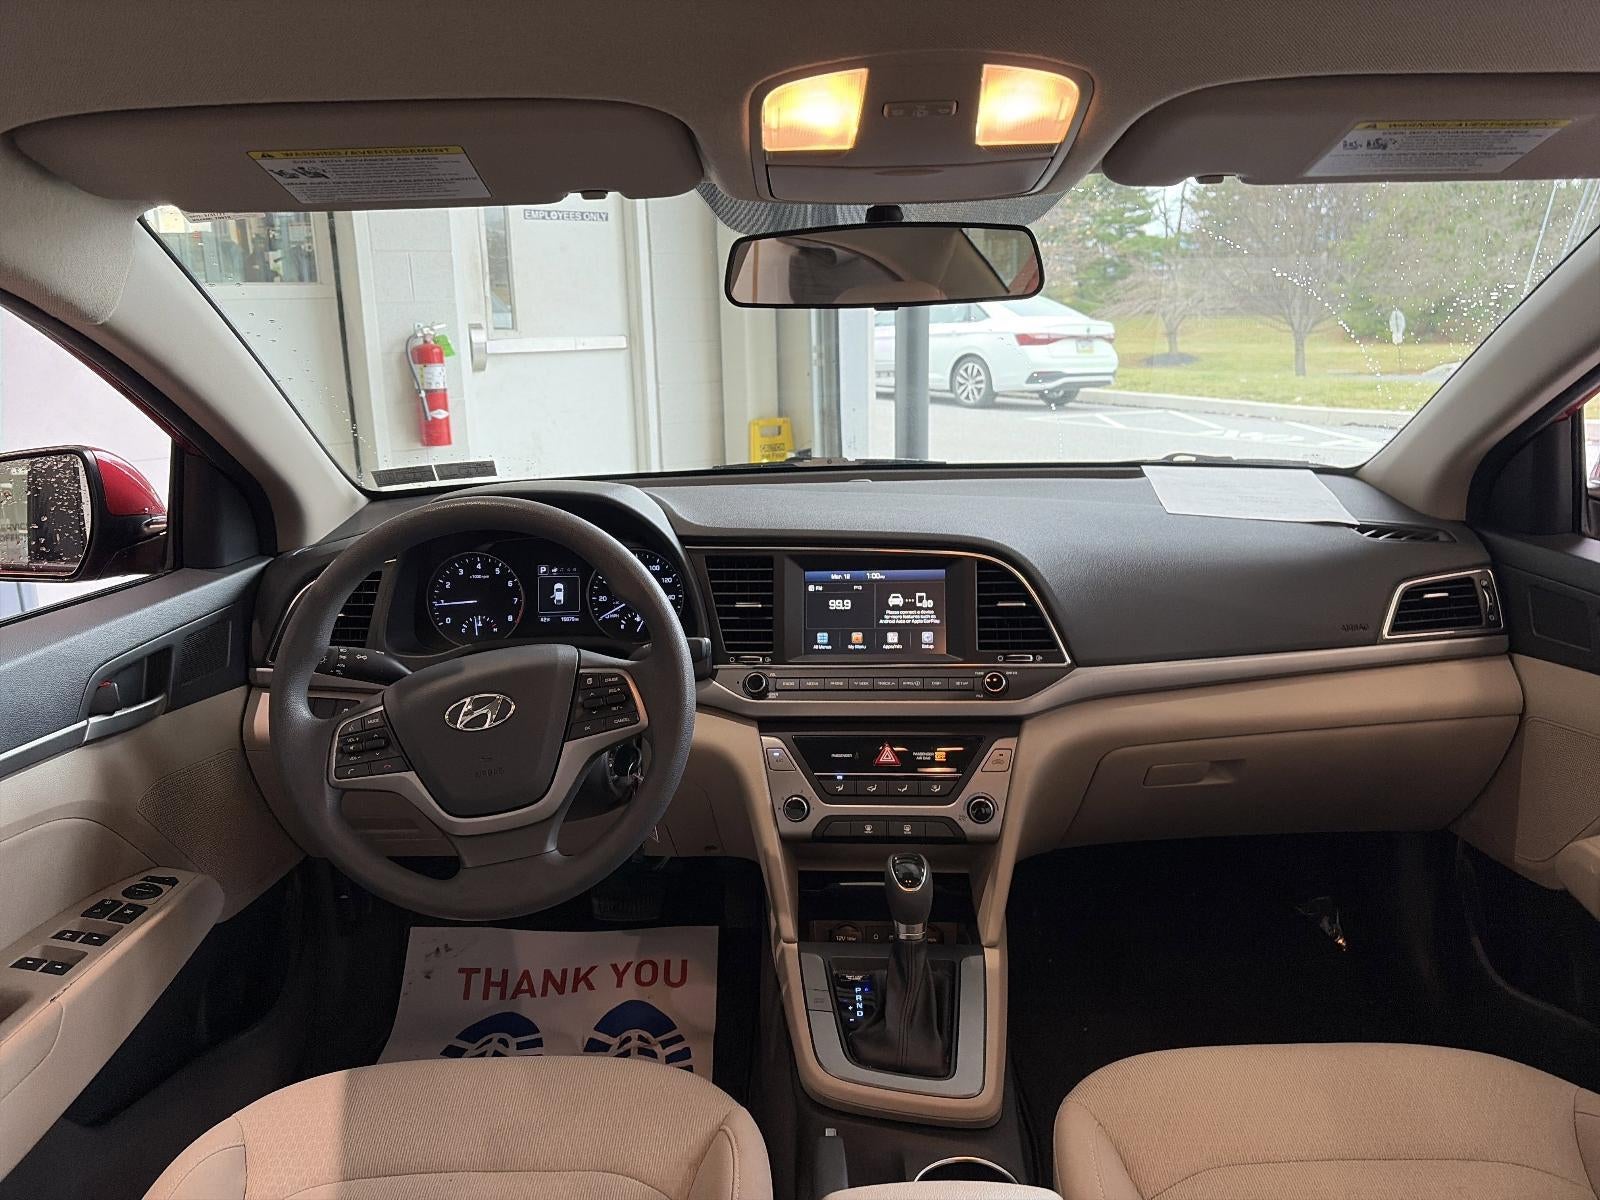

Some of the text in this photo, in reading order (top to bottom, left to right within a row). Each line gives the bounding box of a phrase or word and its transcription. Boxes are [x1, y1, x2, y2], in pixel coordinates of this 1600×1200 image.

[525, 210, 608, 221] EMPLOYEES ONLY
[476, 562, 482, 570] 4
[540, 566, 547, 574] P
[458, 568, 464, 576] 3
[445, 581, 451, 589] 2
[828, 599, 852, 610] 99.9
[458, 958, 689, 1001] THANK YOU
[855, 994, 863, 1002] R
